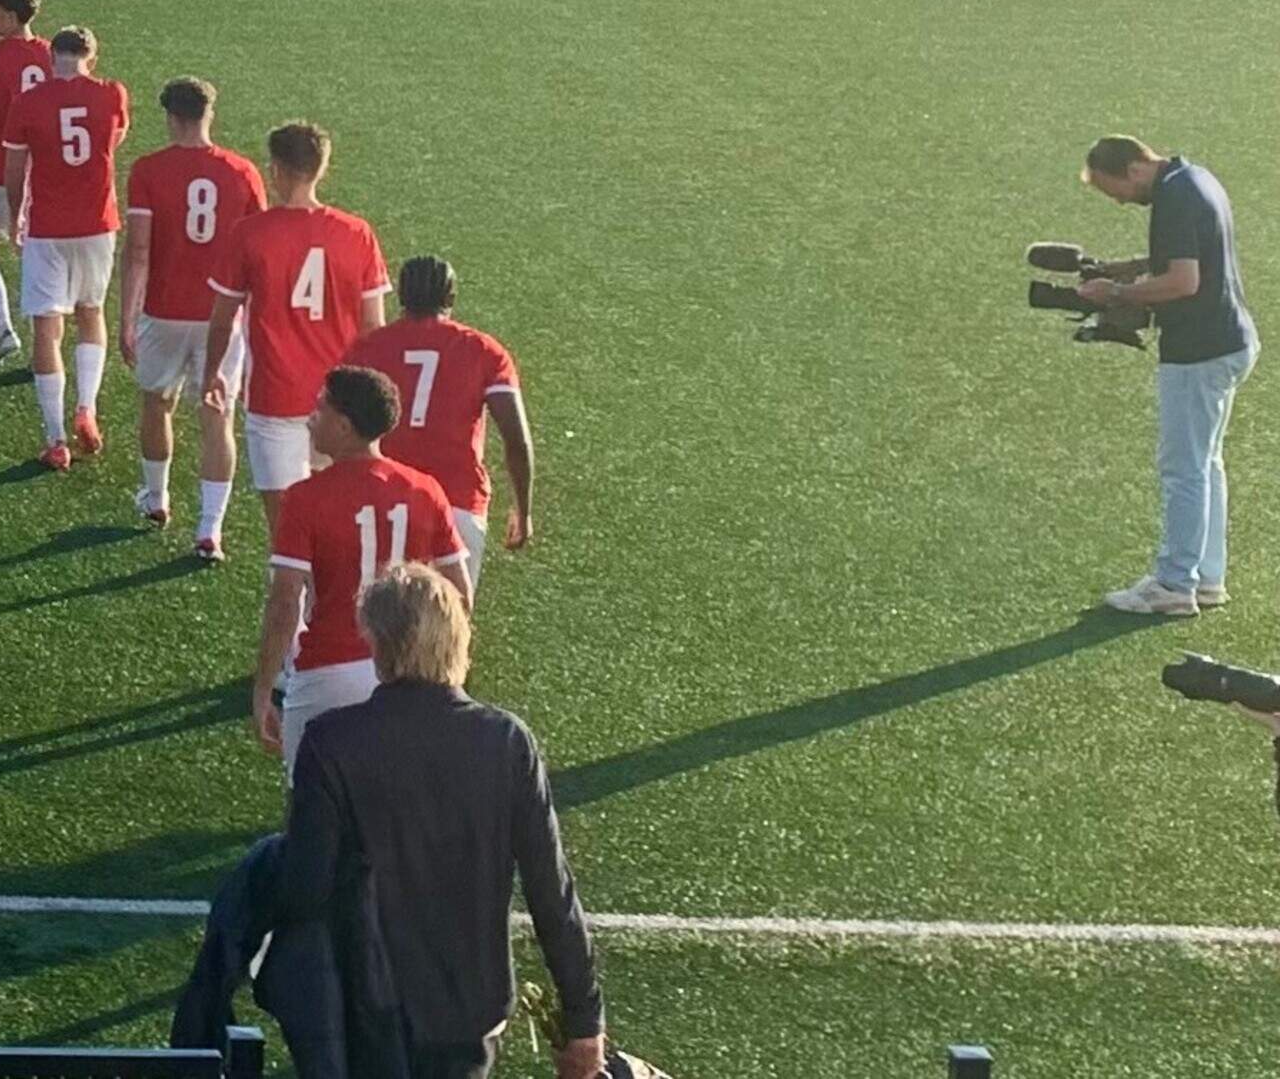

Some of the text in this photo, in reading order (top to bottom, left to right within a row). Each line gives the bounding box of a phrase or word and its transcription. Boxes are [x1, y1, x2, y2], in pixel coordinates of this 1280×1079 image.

[59, 106, 91, 167] 5
[185, 177, 218, 244] 8
[291, 247, 326, 320] 4
[403, 349, 440, 427] 7
[355, 503, 409, 585] 11
